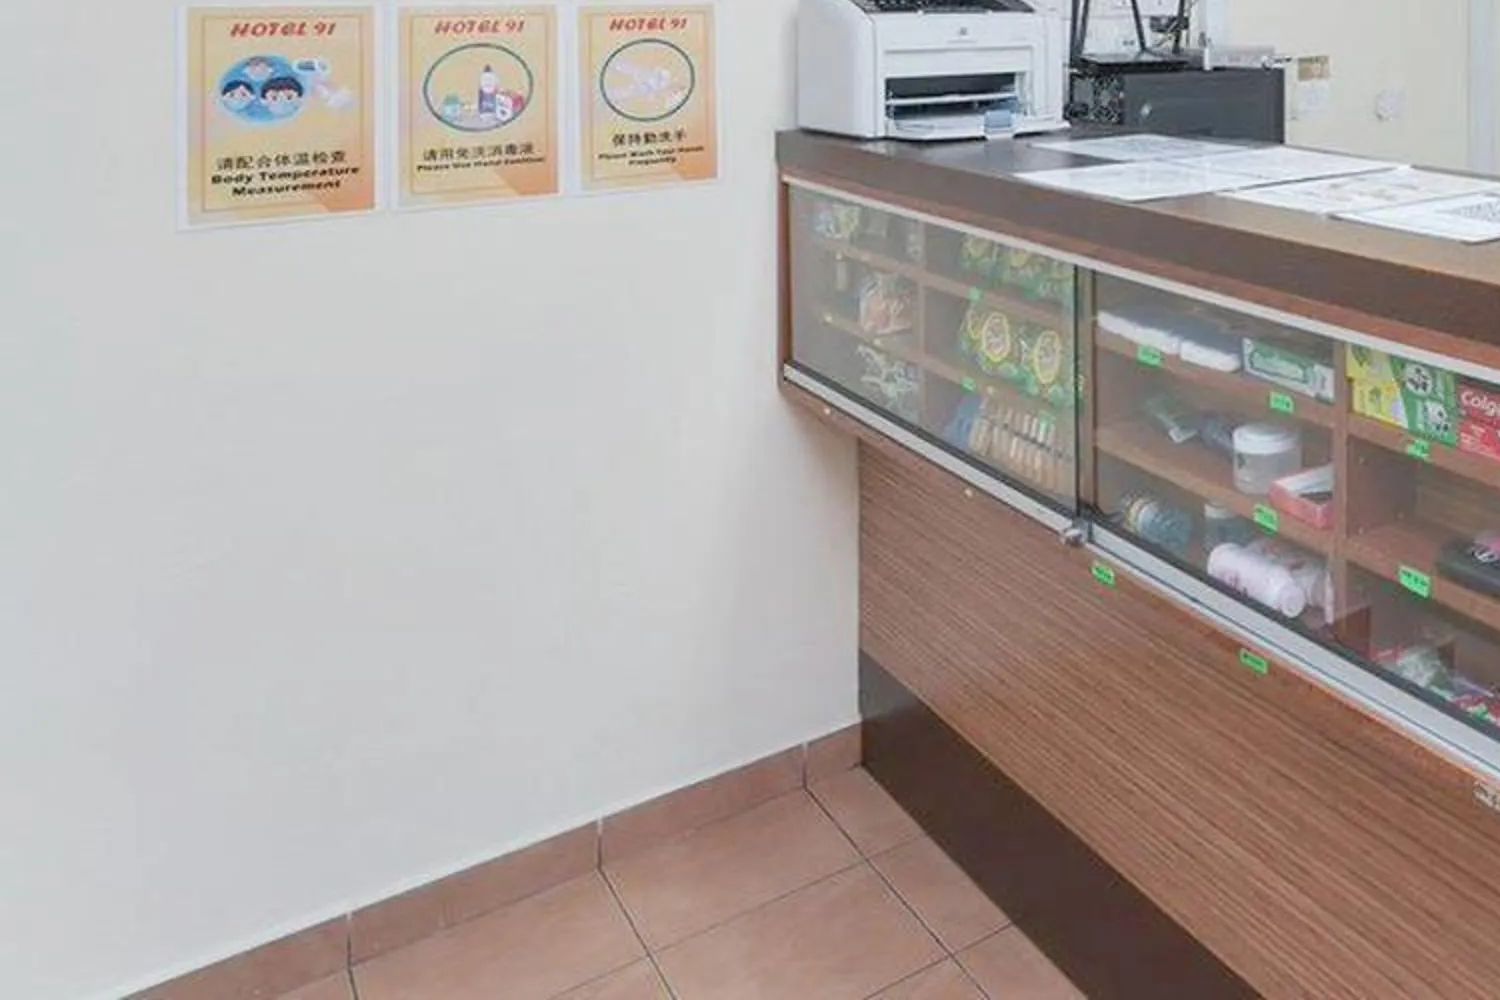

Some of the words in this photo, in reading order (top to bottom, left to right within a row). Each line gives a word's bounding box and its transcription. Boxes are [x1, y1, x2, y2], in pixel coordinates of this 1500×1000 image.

[230, 21, 306, 38] HOTEL
[313, 21, 337, 36] 91
[434, 19, 501, 35] HOTEL
[505, 19, 525, 33] 91
[609, 17, 666, 31] HOTEL
[670, 17, 688, 30] 91
[216, 149, 347, 171] 请配合体温检查
[211, 172, 253, 186] Body
[259, 165, 360, 182] Temperature
[231, 179, 341, 197] Measurement
